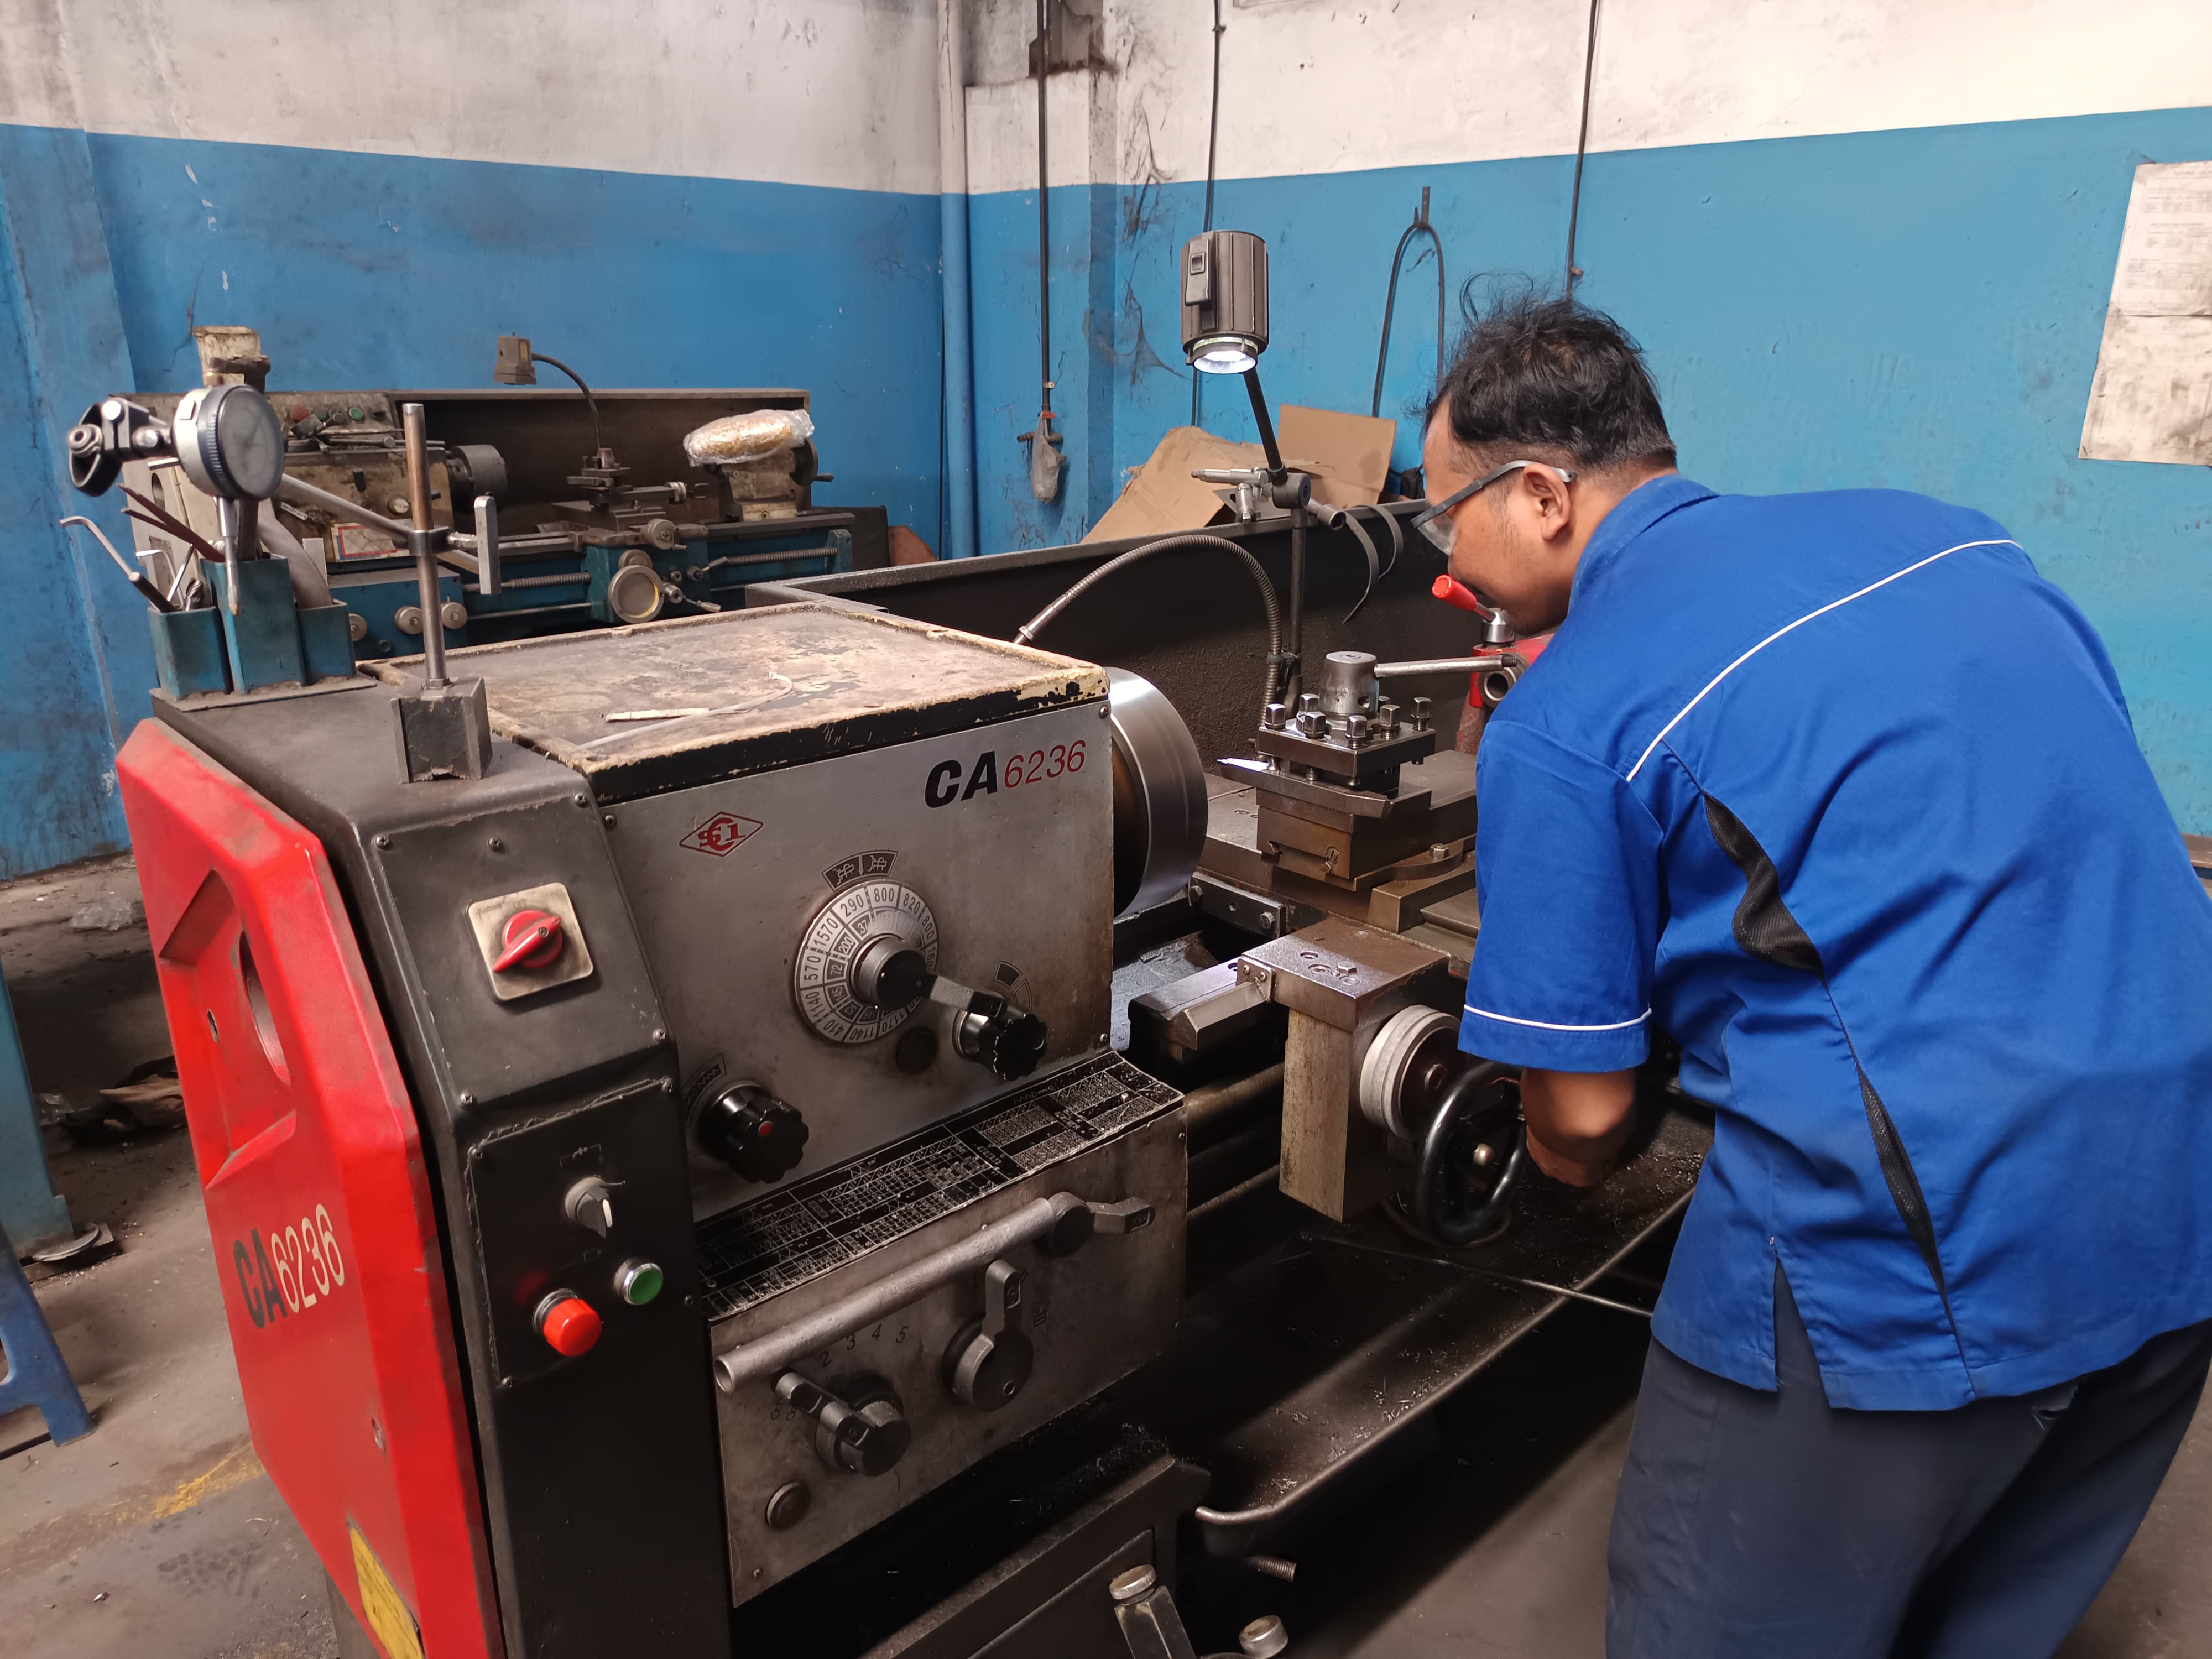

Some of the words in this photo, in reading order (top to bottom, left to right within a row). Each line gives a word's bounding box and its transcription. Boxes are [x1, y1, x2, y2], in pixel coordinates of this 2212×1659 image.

[925, 739, 1087, 808] CA6236
[841, 894, 864, 917] 290
[874, 888, 895, 902] 800
[902, 893, 921, 914] 820
[813, 916, 839, 948] 1570
[858, 920, 868, 934] 37
[922, 915, 935, 940] 800
[838, 937, 855, 954] 200
[804, 956, 821, 980] 570
[830, 964, 843, 975] 72
[805, 991, 826, 1018] 1140
[831, 986, 846, 1002] 145
[823, 1019, 844, 1037] 410
[881, 1011, 905, 1032] 1170
[850, 1025, 875, 1041] 1140
[233, 1203, 345, 1329] CA6236
[820, 1350, 832, 1368] 2
[846, 1334, 856, 1350] 3
[872, 1323, 882, 1341] 4
[896, 1326, 909, 1344] 5
